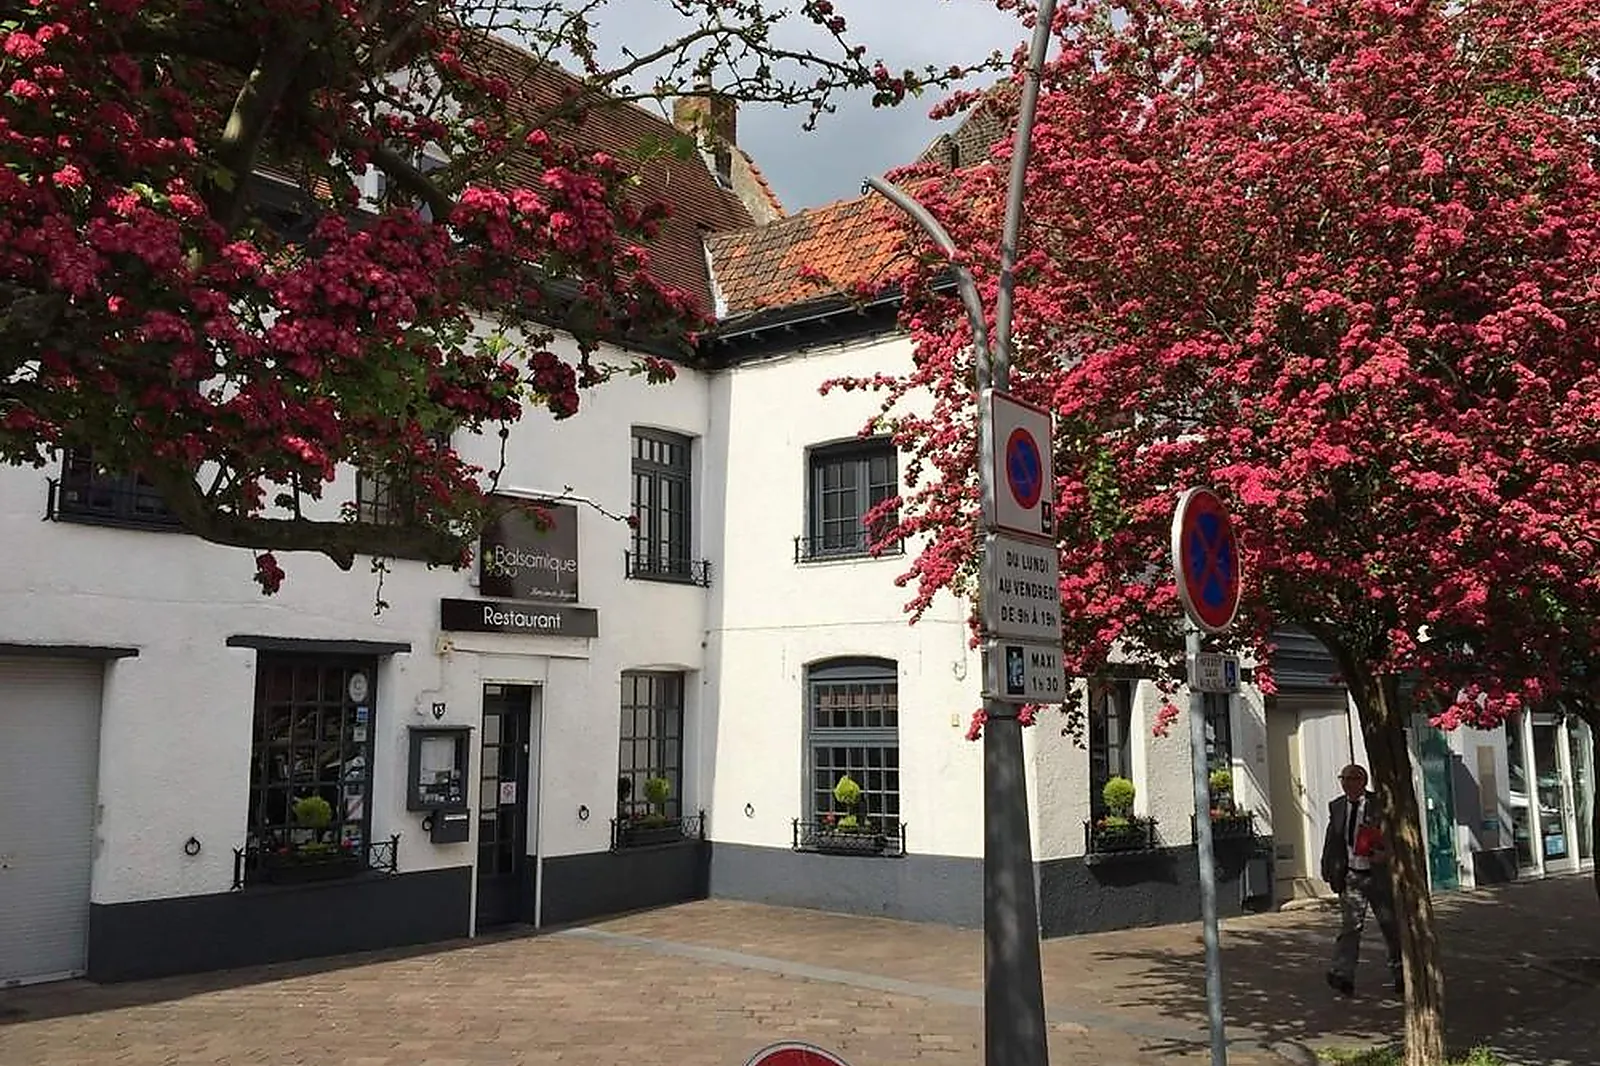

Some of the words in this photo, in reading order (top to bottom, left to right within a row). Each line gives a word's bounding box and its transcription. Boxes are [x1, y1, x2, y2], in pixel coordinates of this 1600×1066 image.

[495, 545, 577, 584] Balsamique
[1006, 551, 1019, 568] DU
[1022, 555, 1049, 573] LUNDI
[999, 577, 1012, 593] AU
[483, 606, 561, 629] Restaurant
[1001, 606, 1015, 622] DE
[1031, 652, 1056, 668] MAXI
